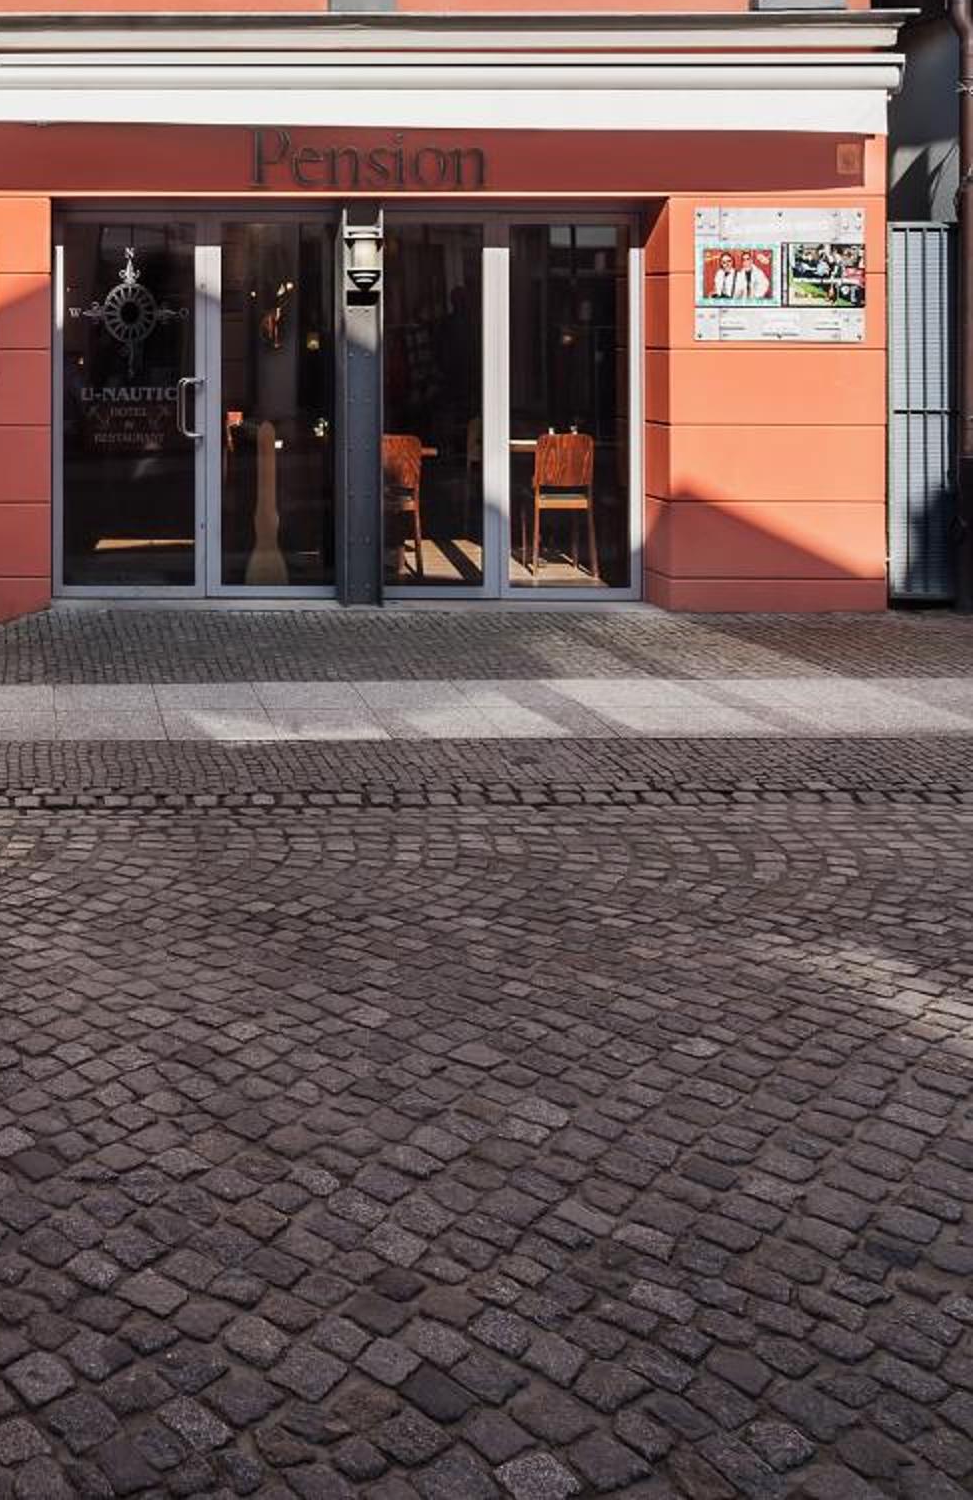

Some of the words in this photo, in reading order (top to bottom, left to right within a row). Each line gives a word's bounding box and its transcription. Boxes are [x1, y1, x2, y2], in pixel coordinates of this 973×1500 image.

[248, 130, 485, 188] Pension
[125, 247, 135, 259] N
[68, 307, 82, 318] W
[81, 387, 179, 401] U-NAUTIC
